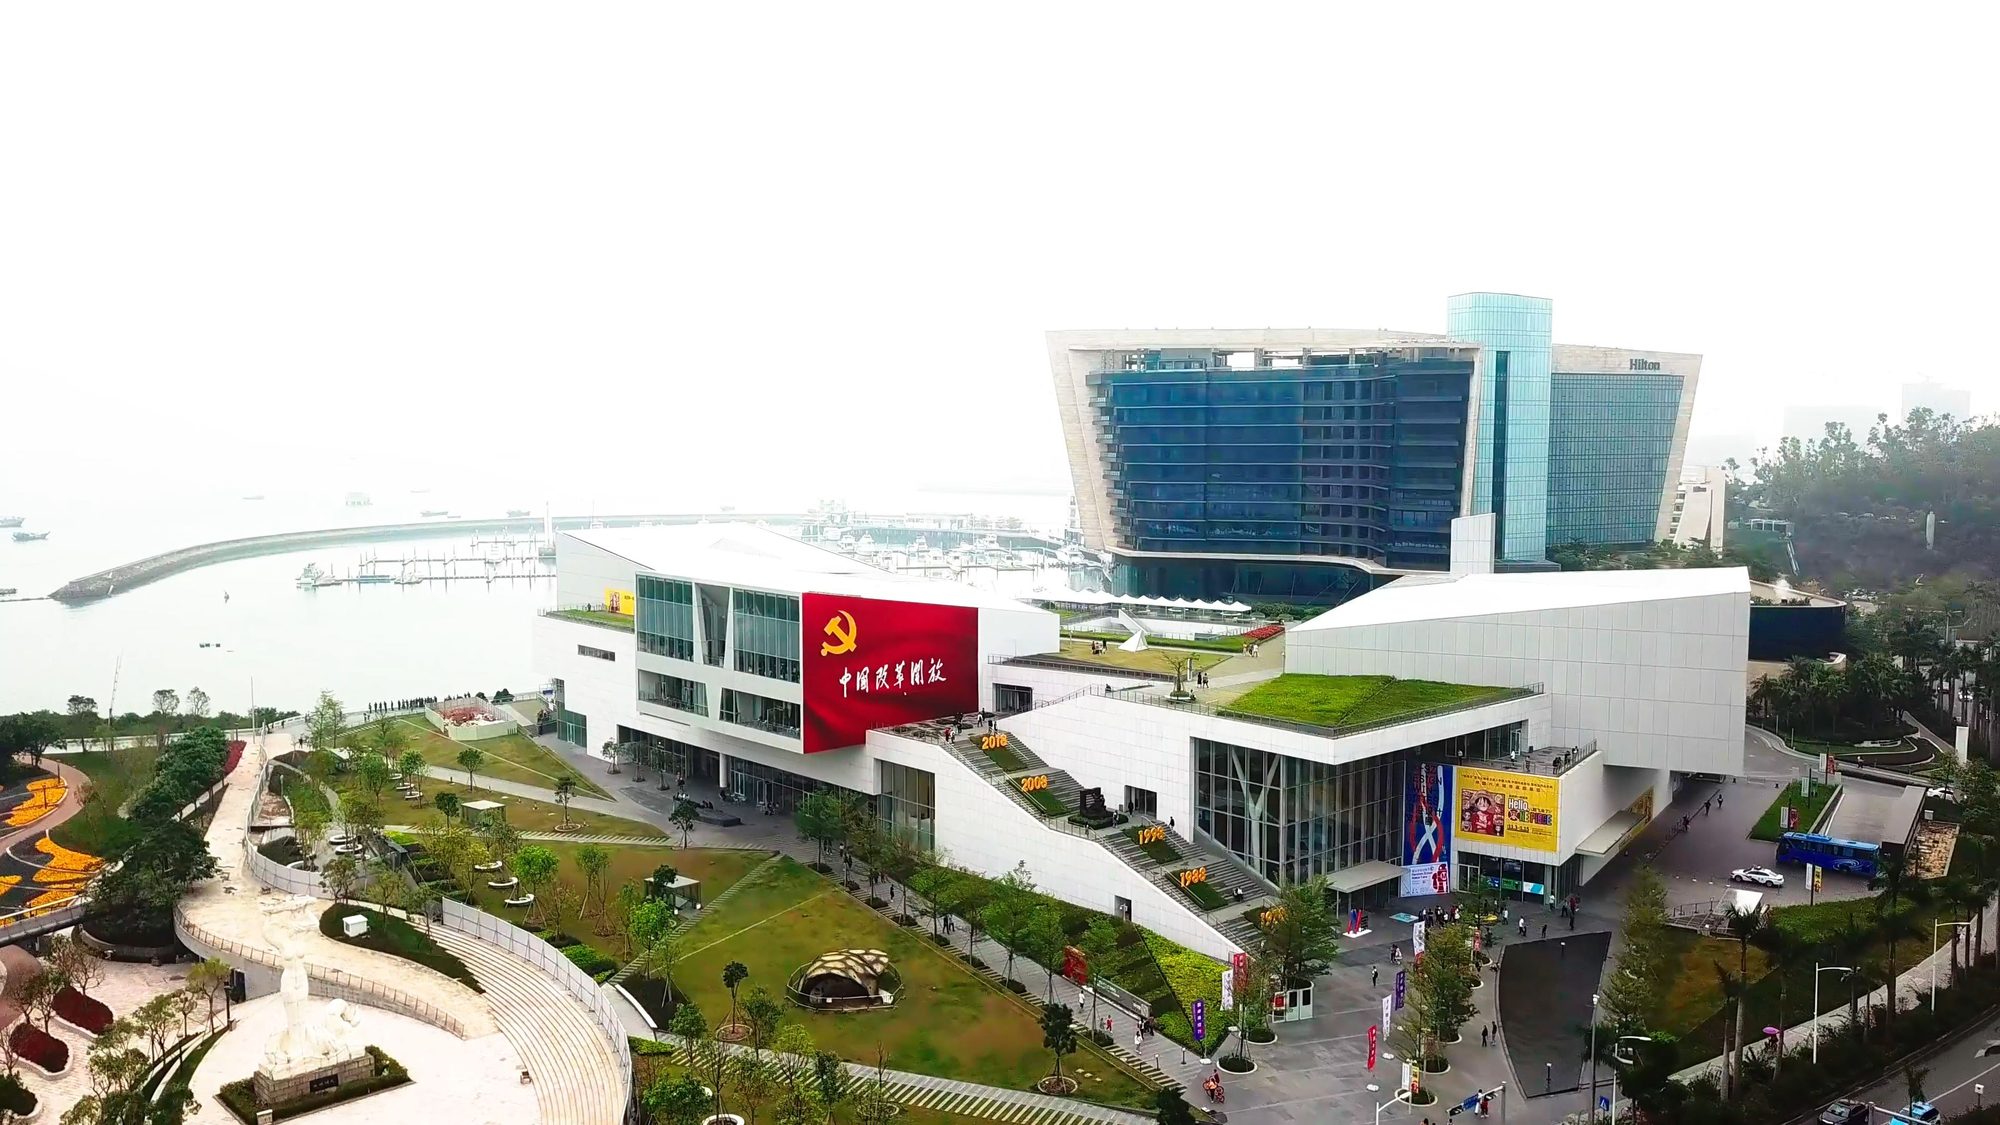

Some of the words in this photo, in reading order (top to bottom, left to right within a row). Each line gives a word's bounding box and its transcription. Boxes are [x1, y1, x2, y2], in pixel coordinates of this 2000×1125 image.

[1630, 358, 1661, 371] Hilton
[982, 733, 1008, 750] 2018
[1021, 774, 1048, 792] 2008
[1138, 826, 1165, 845] 1998
[1180, 866, 1207, 888] 1988
